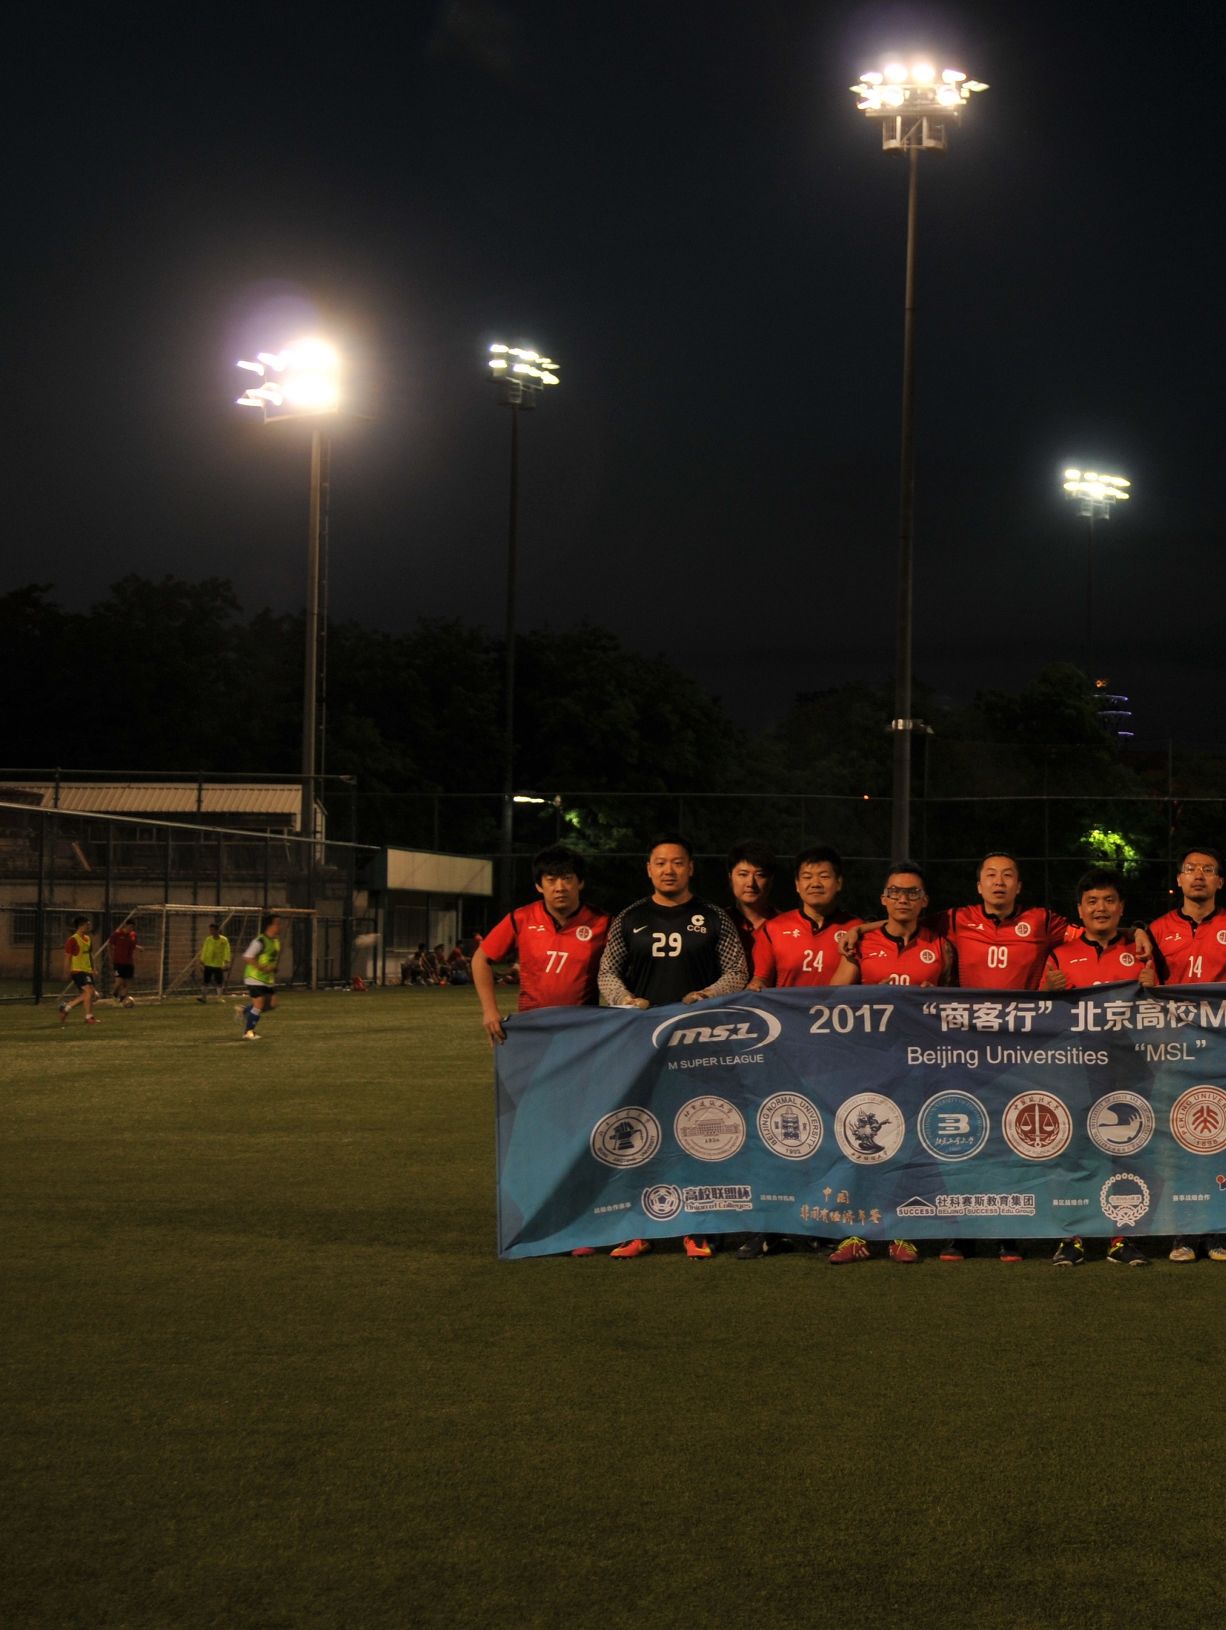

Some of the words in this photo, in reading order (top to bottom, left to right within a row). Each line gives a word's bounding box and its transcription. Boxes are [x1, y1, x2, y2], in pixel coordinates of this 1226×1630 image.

[651, 931, 683, 958] 29
[545, 950, 569, 975] 77
[802, 949, 824, 973] 24
[987, 946, 1008, 969] 09
[1188, 954, 1202, 979] 14
[808, 1004, 896, 1035] 2017
[668, 1061, 679, 1071] M
[680, 1056, 718, 1069] SUPER
[719, 1053, 765, 1066] LEAGUE
[907, 1044, 979, 1069] Beijing
[986, 1044, 1109, 1066] Universities
[1134, 1039, 1207, 1062] “MSL”
[766, 1096, 798, 1113] NORMAL
[761, 1113, 778, 1146] BEIJING
[799, 1100, 819, 1149] UNIVERSITY
[684, 1186, 750, 1202] 高校联盟杯
[937, 1195, 1034, 1208] 社科赛斯教育集团
[898, 1208, 935, 1216] SUCCESS
